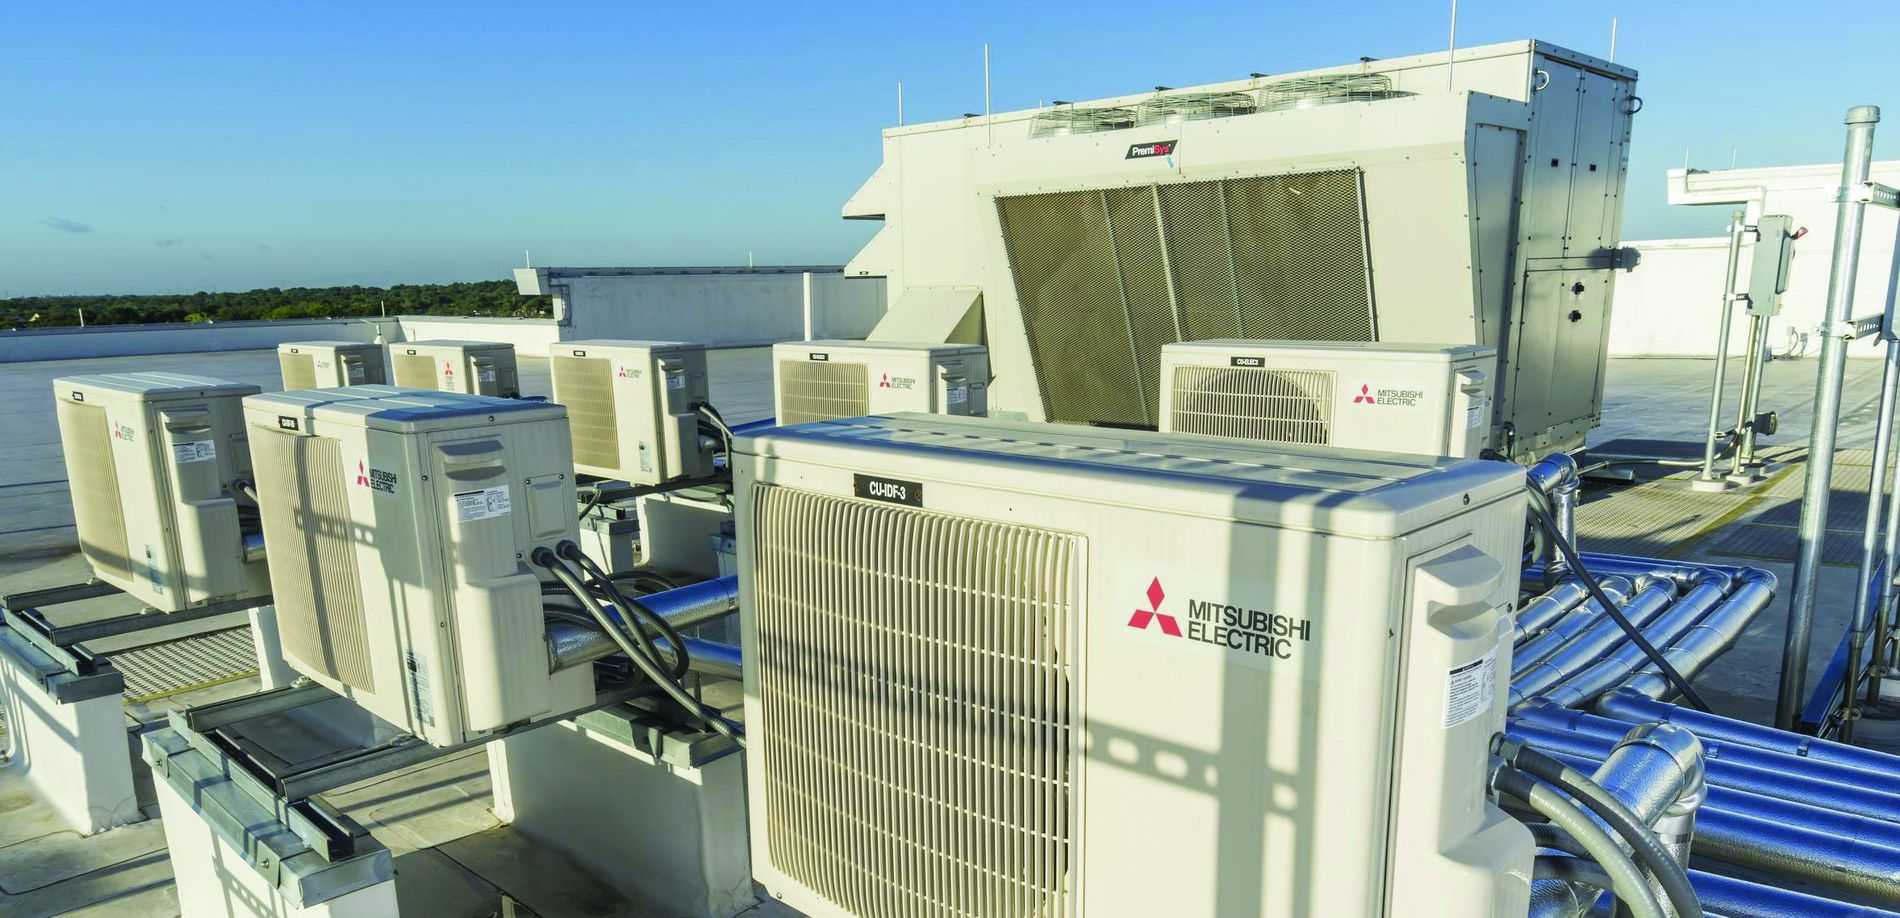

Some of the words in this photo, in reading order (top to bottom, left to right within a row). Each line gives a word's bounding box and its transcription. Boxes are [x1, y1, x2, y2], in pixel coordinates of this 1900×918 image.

[1132, 143, 1170, 156] PremiSys
[1377, 389, 1423, 399] MITSUBISHI
[1377, 397, 1416, 406] ELECTRIC
[369, 468, 397, 484] MITSUBISHI
[370, 478, 395, 494] ELECTRIC
[869, 481, 906, 500] CU-IDF-3
[1188, 598, 1311, 641] MITSUBISHI
[1187, 620, 1293, 660] ELECTRIC
